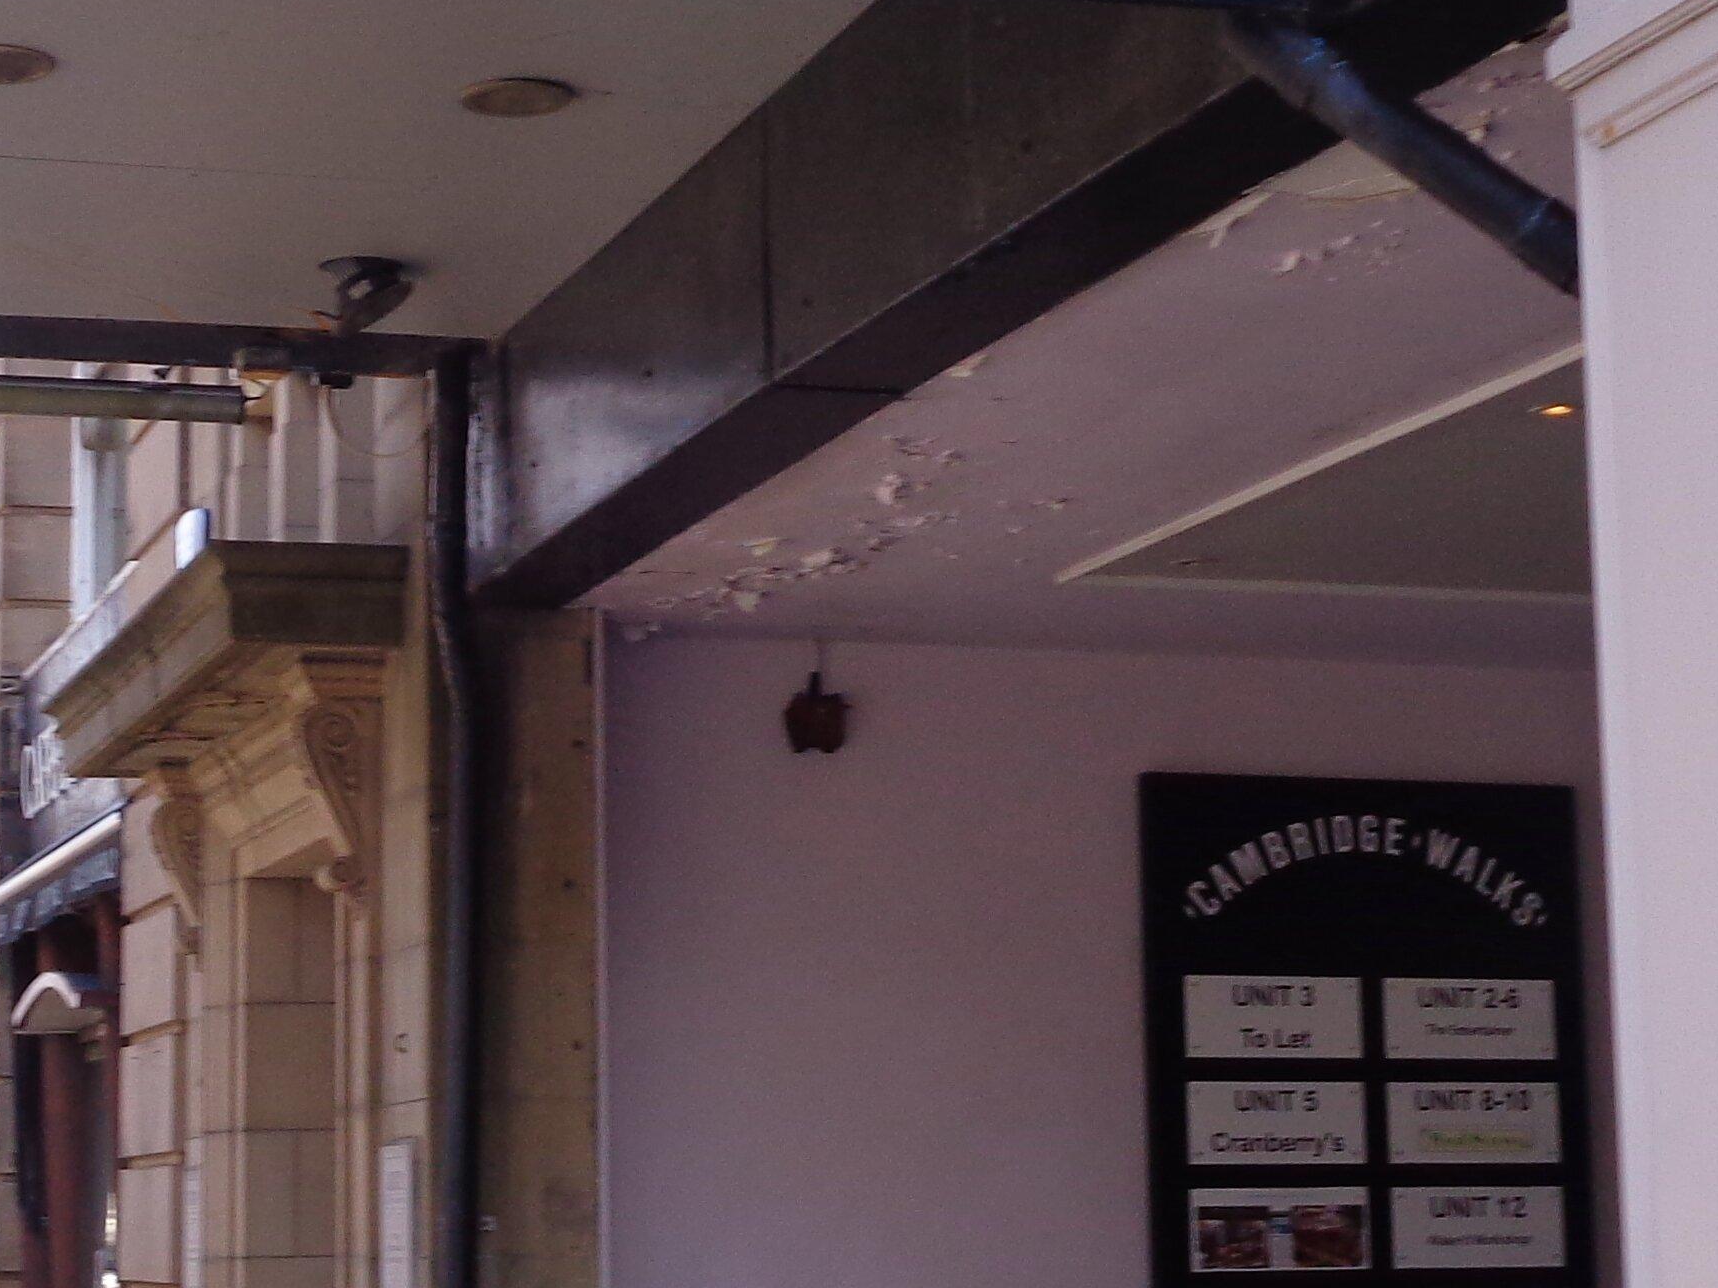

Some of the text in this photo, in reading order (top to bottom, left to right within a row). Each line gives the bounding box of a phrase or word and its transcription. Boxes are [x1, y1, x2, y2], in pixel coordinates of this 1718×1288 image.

[1187, 815, 1545, 926] CAMBRIDGE WALKS
[1232, 985, 1291, 1007] UNIT
[1416, 987, 1474, 1009] UNIT
[1239, 1028, 1270, 1049] To
[1234, 1090, 1296, 1112] UNIT
[1414, 1089, 1473, 1112] UNIT
[1210, 1132, 1344, 1157] Cranberry's
[1428, 1196, 1489, 1218] UNIT
